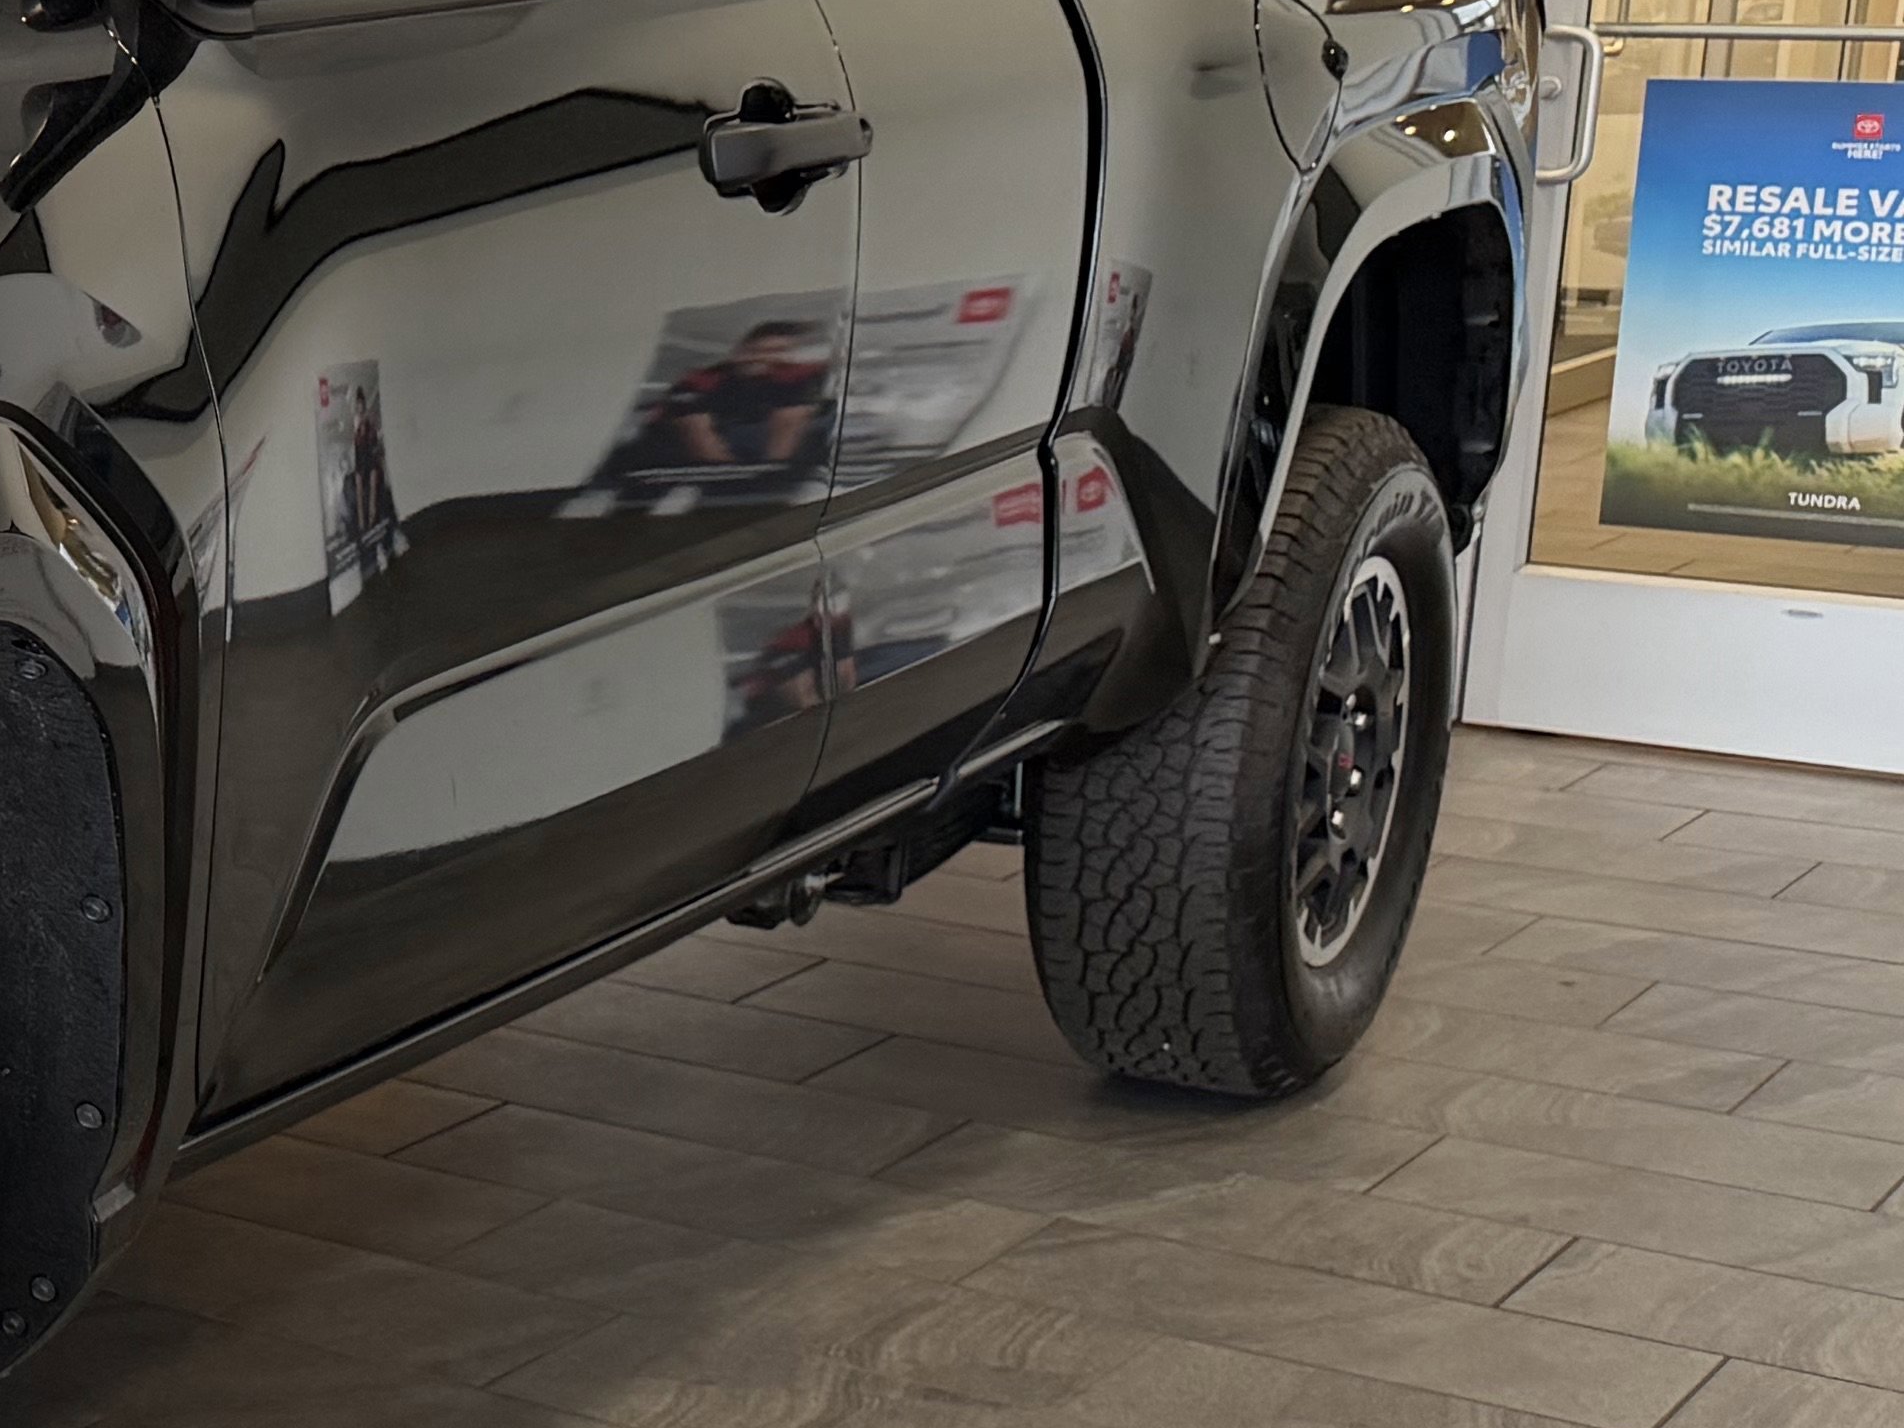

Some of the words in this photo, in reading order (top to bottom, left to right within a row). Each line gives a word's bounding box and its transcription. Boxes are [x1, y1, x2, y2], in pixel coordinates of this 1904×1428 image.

[1707, 184, 1860, 217] RESALE
[1702, 213, 1806, 240] $7,681
[1702, 239, 1792, 259] SIMILAR
[1795, 243, 1904, 264] FULL-SIZE
[1788, 492, 1862, 512] TUNDRA
